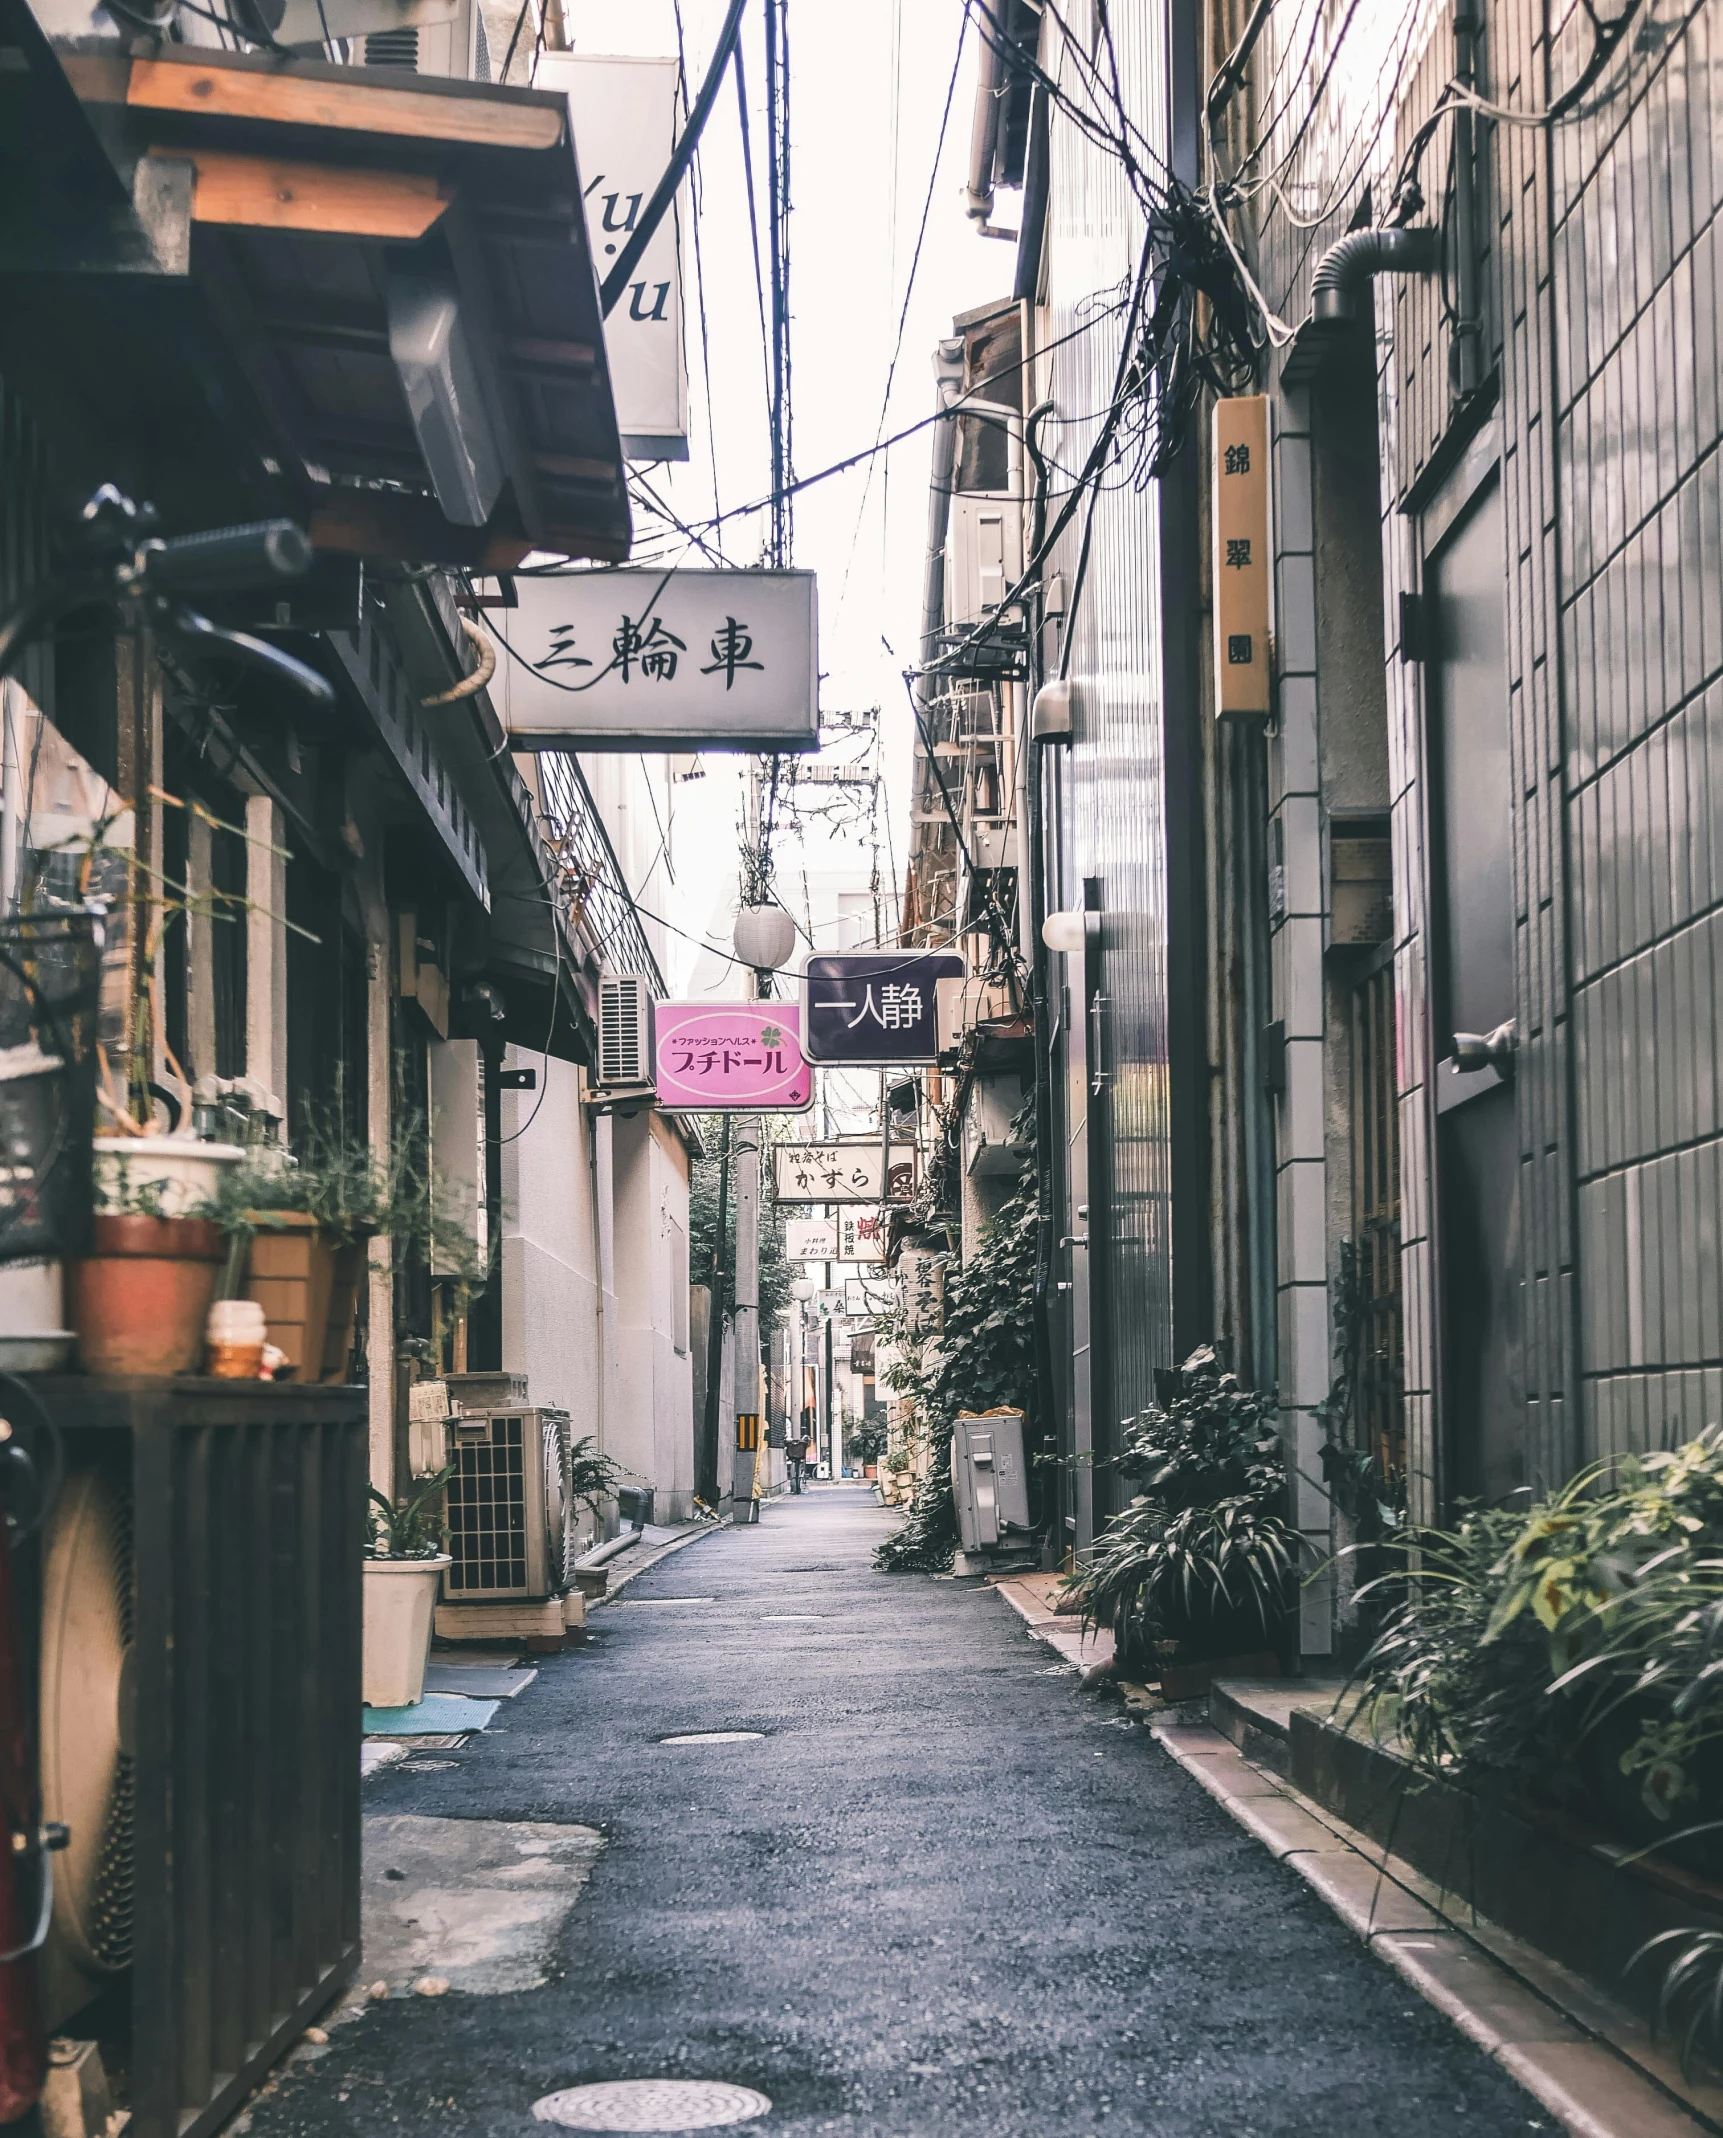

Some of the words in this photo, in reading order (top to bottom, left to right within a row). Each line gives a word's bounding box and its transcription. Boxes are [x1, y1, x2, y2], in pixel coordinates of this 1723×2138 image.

[584, 176, 643, 232] u
[533, 615, 765, 691] 三輪車
[814, 983, 924, 1029] 一人静
[678, 1037, 751, 1046] ファッションヘルス
[671, 1050, 788, 1075] プチドール
[795, 1168, 869, 1190] かずら
[844, 1220, 855, 1256] 鉄板焼
